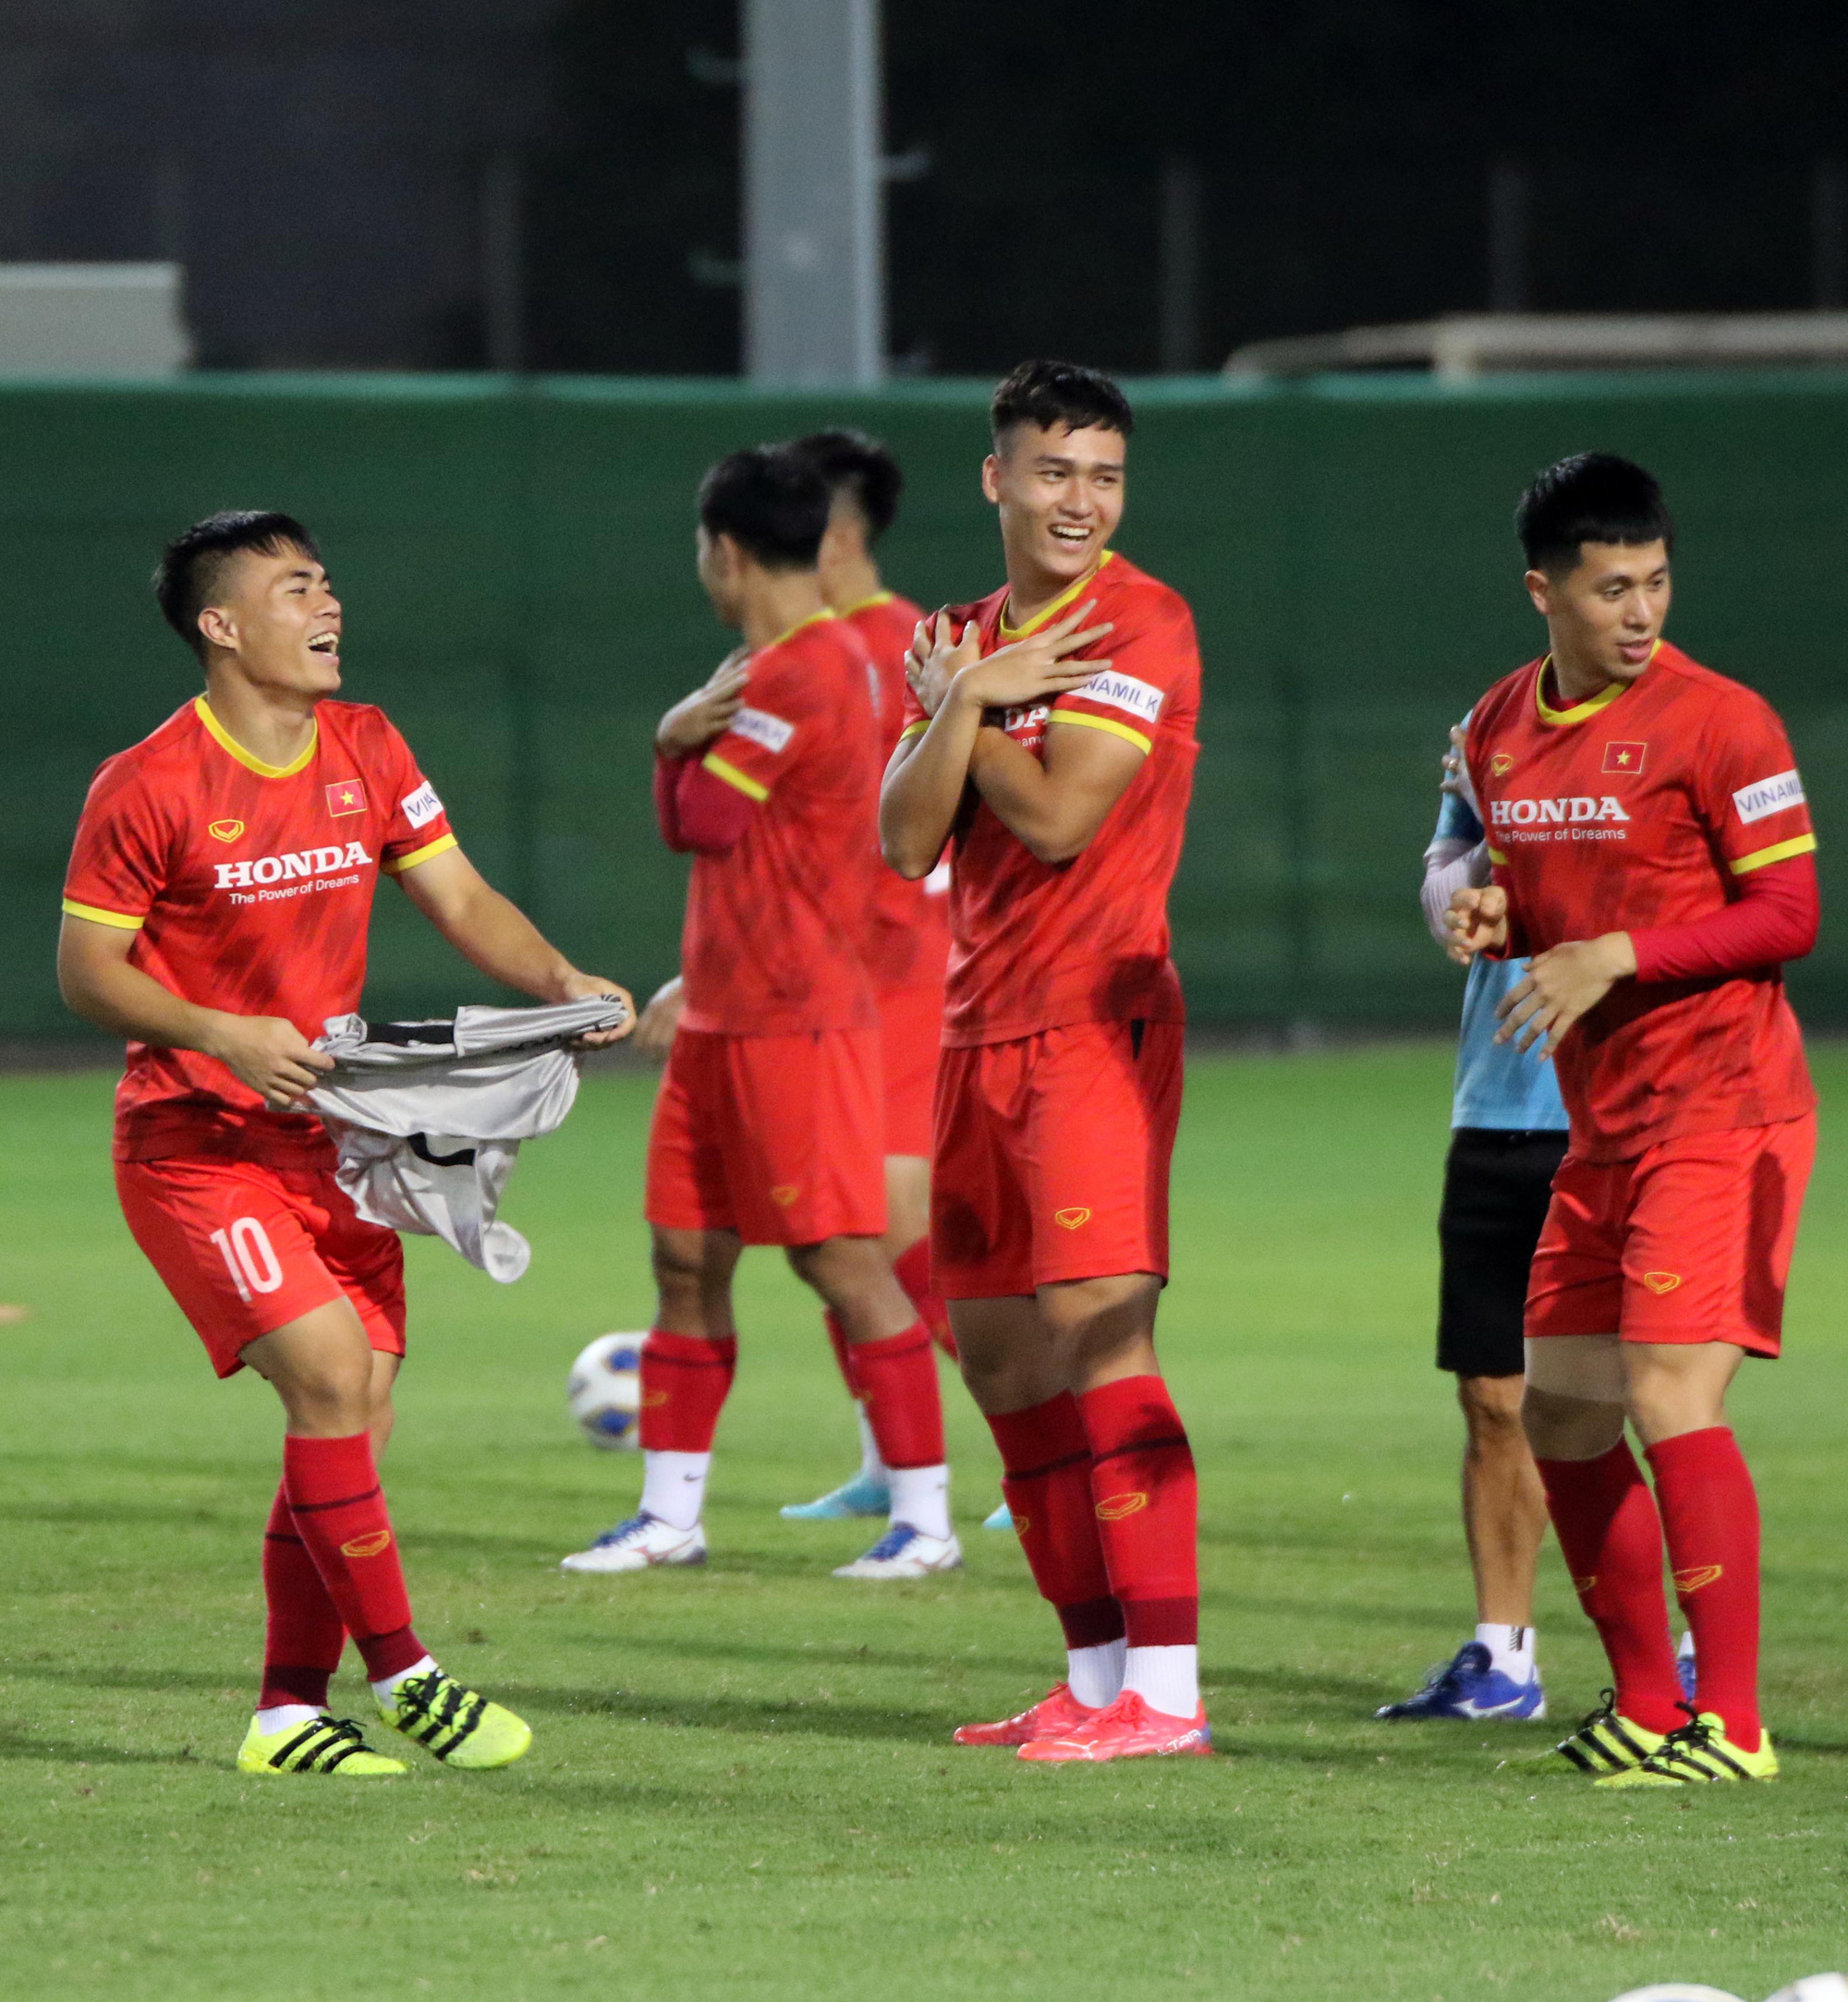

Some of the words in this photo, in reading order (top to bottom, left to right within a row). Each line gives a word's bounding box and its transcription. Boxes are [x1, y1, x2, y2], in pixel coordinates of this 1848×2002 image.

[1083, 677, 1158, 714] NAMILK
[1489, 796, 1630, 824] HONDA
[1512, 830, 1551, 842] Power
[1554, 828, 1569, 840] of
[1572, 828, 1626, 840] Dreams
[213, 841, 373, 889] HONDA
[228, 892, 255, 905] The
[259, 886, 299, 902] Power
[299, 880, 313, 894] of
[316, 874, 359, 892] Dreams
[210, 1217, 283, 1304] 10
